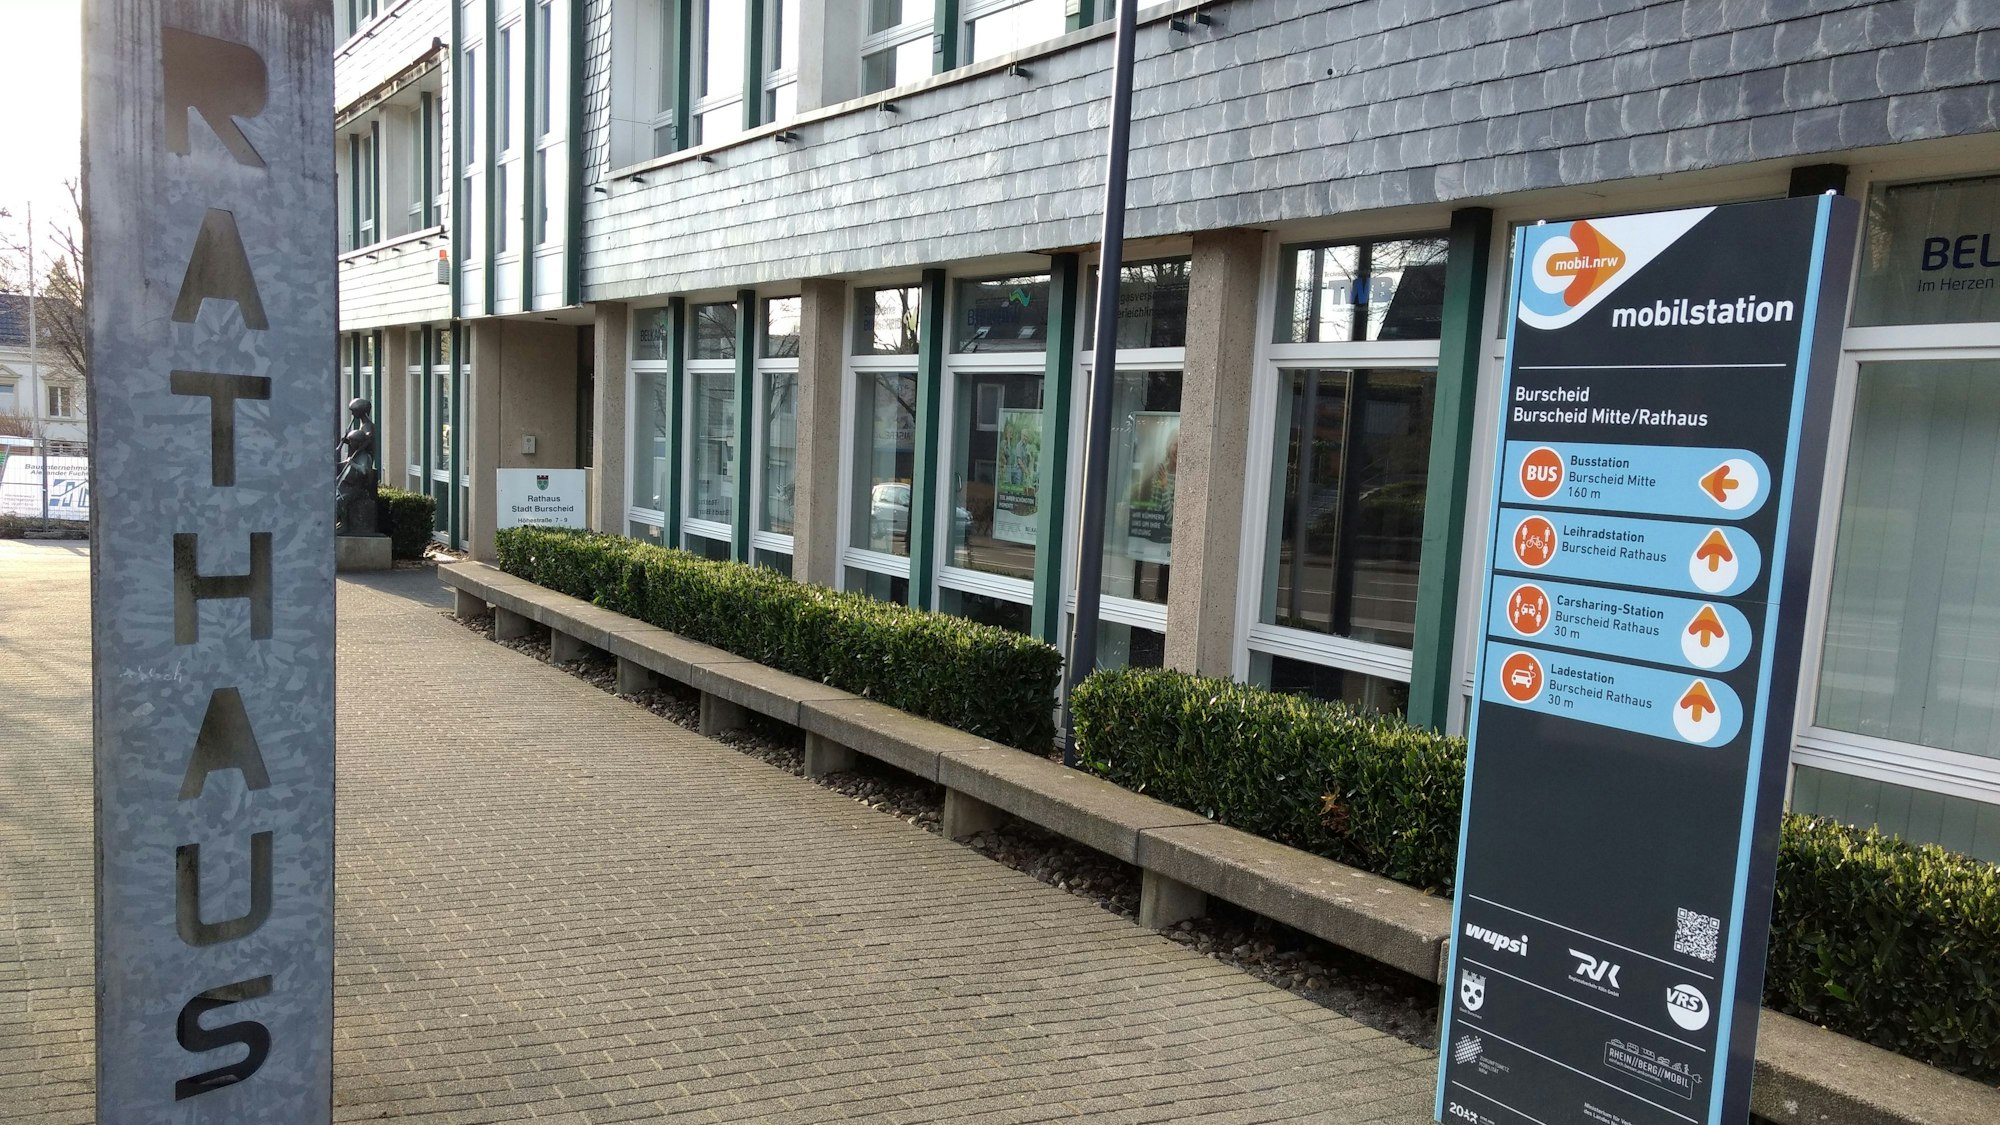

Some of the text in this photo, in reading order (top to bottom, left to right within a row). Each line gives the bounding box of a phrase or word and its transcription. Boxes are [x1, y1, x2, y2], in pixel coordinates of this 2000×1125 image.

[1555, 255, 1619, 272] mobil.nrw
[1918, 277, 1994, 292] Im Herzen
[1611, 295, 1794, 328] mobilstation
[1515, 387, 1590, 402] Burscheid
[1513, 407, 1708, 427] Burscheid Mitte/Rathaus
[1570, 455, 1629, 469] Busstation
[1526, 465, 1558, 482] BUS
[1569, 471, 1656, 487] Burscheid Mitte
[1568, 486, 1601, 499] 160 m
[1563, 525, 1645, 543] Leihradstation
[1562, 542, 1667, 562] Burscheid Rathaus
[162, 26, 273, 1101] RATHAUS
[1557, 594, 1664, 619] Carsharing-Station
[1554, 625, 1580, 639] 30 m
[1555, 610, 1660, 636] Burscheid Rathaus
[1550, 663, 1615, 685] Ladestation
[1548, 694, 1574, 709] 30 m
[1549, 679, 1653, 709] Burscheid Rathaus
[1465, 922, 1528, 957] wupsi
[1666, 987, 1700, 1011] VRS
